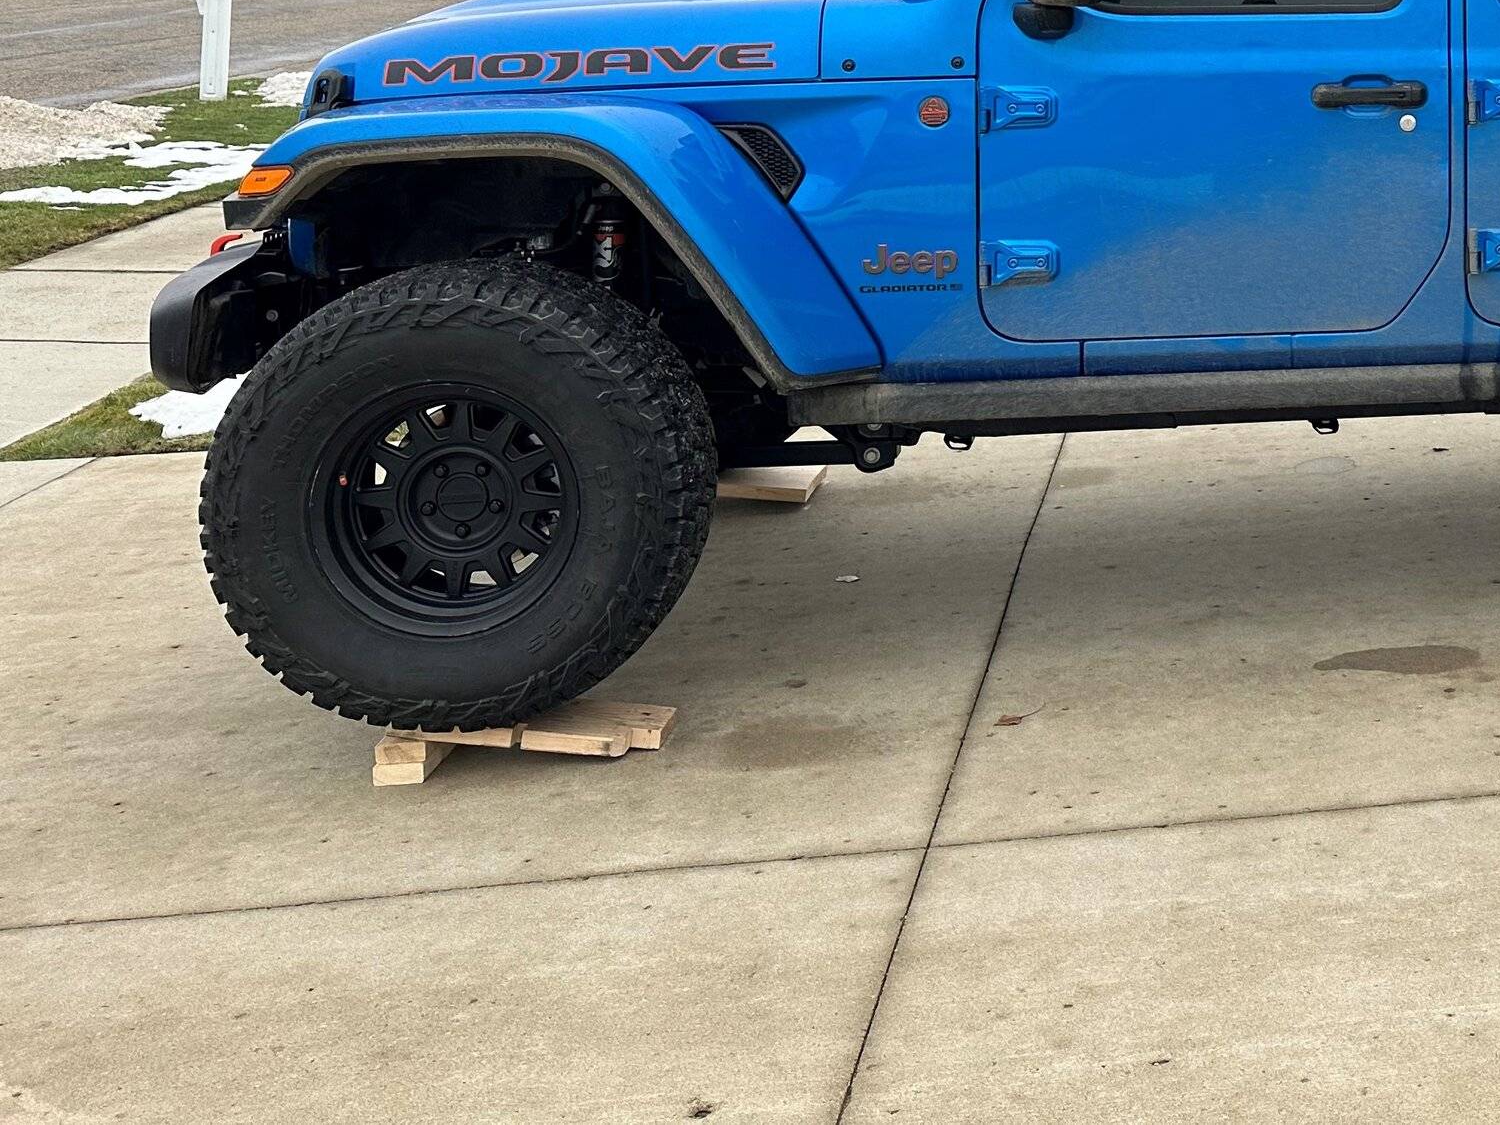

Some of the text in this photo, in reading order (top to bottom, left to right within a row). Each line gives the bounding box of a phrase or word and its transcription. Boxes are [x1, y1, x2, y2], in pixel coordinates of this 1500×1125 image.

[383, 42, 776, 86] MOJAVE
[862, 243, 959, 279] Jeep
[859, 283, 947, 293] GLADIATOR
[259, 496, 299, 604] MICKEY
[527, 577, 599, 655] BOSS
